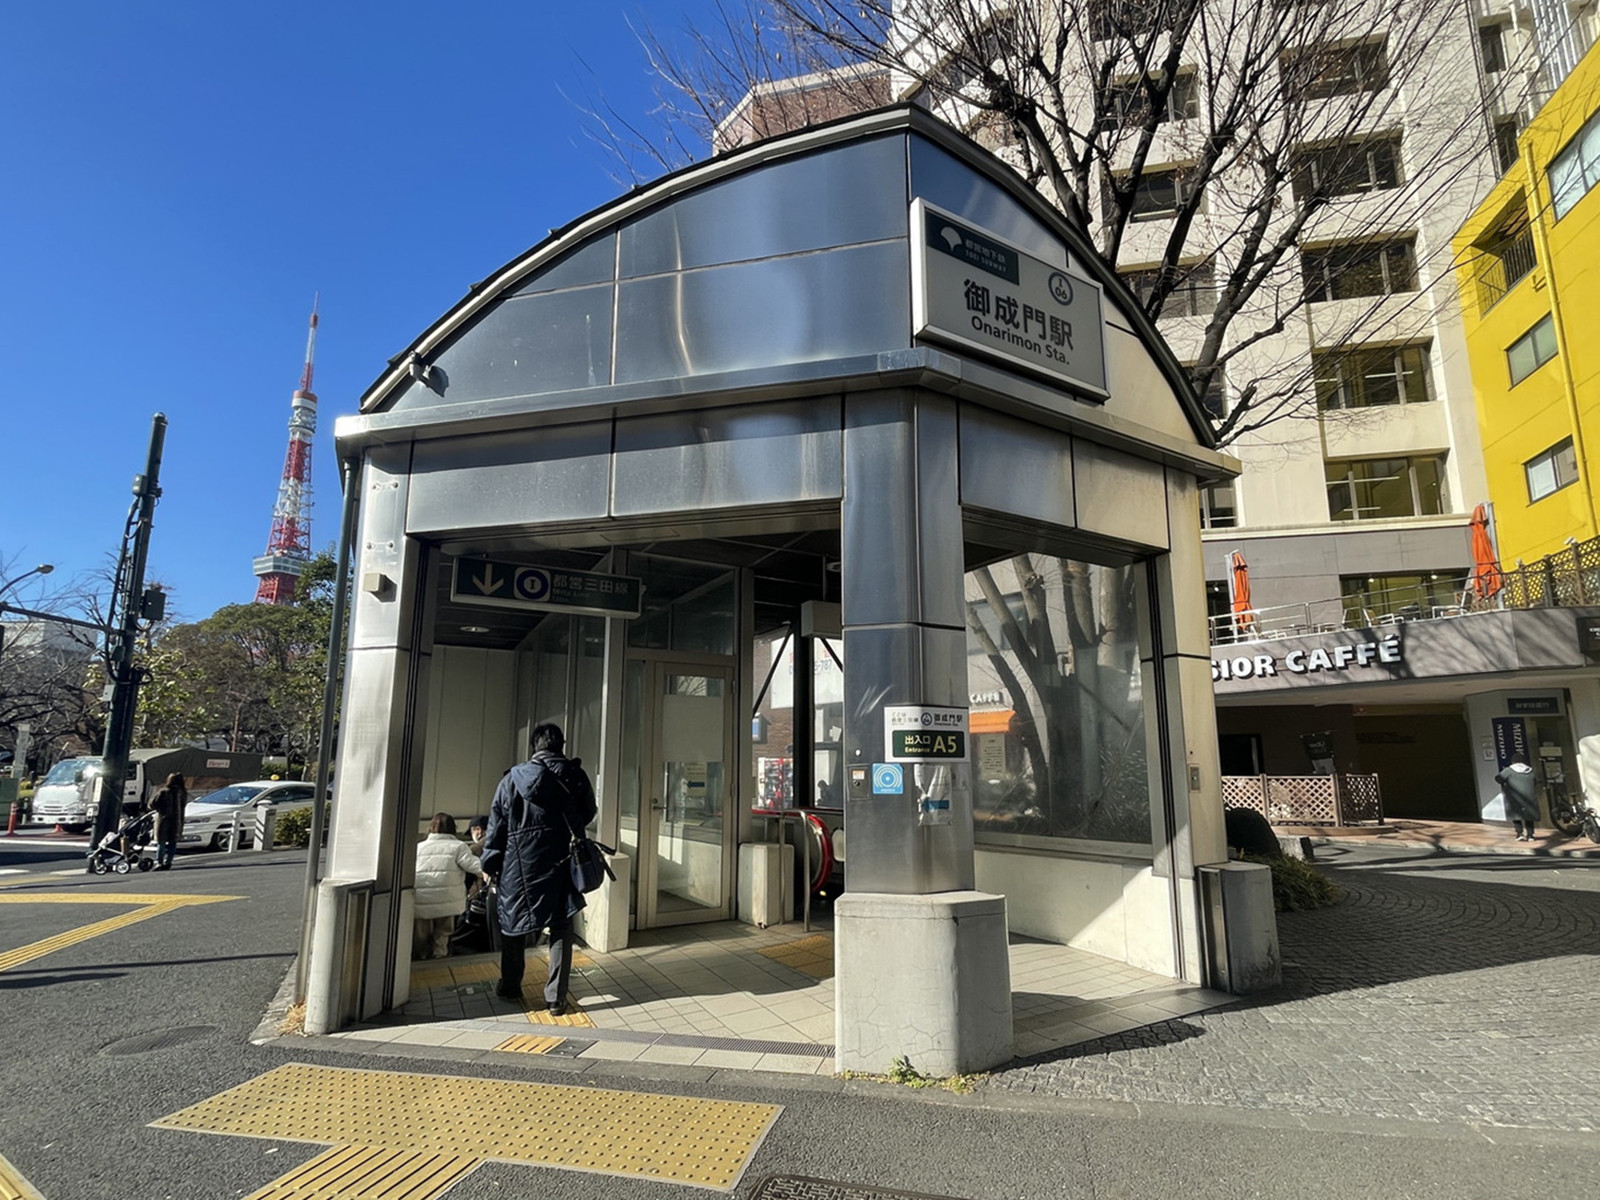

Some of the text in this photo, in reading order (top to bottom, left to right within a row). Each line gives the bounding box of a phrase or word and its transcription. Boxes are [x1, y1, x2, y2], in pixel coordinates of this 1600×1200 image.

[980, 256, 1007, 273] SUBWAY
[1055, 287, 1068, 301] 06
[964, 278, 1074, 351] 御成門駅
[971, 315, 1070, 365] Onarimon Sta.
[553, 574, 628, 595] 都営三田線
[1285, 634, 1401, 673] CAFFÉ
[905, 735, 930, 745] 出入口
[933, 735, 957, 753] A5
[1497, 723, 1507, 760] MIZUHO
